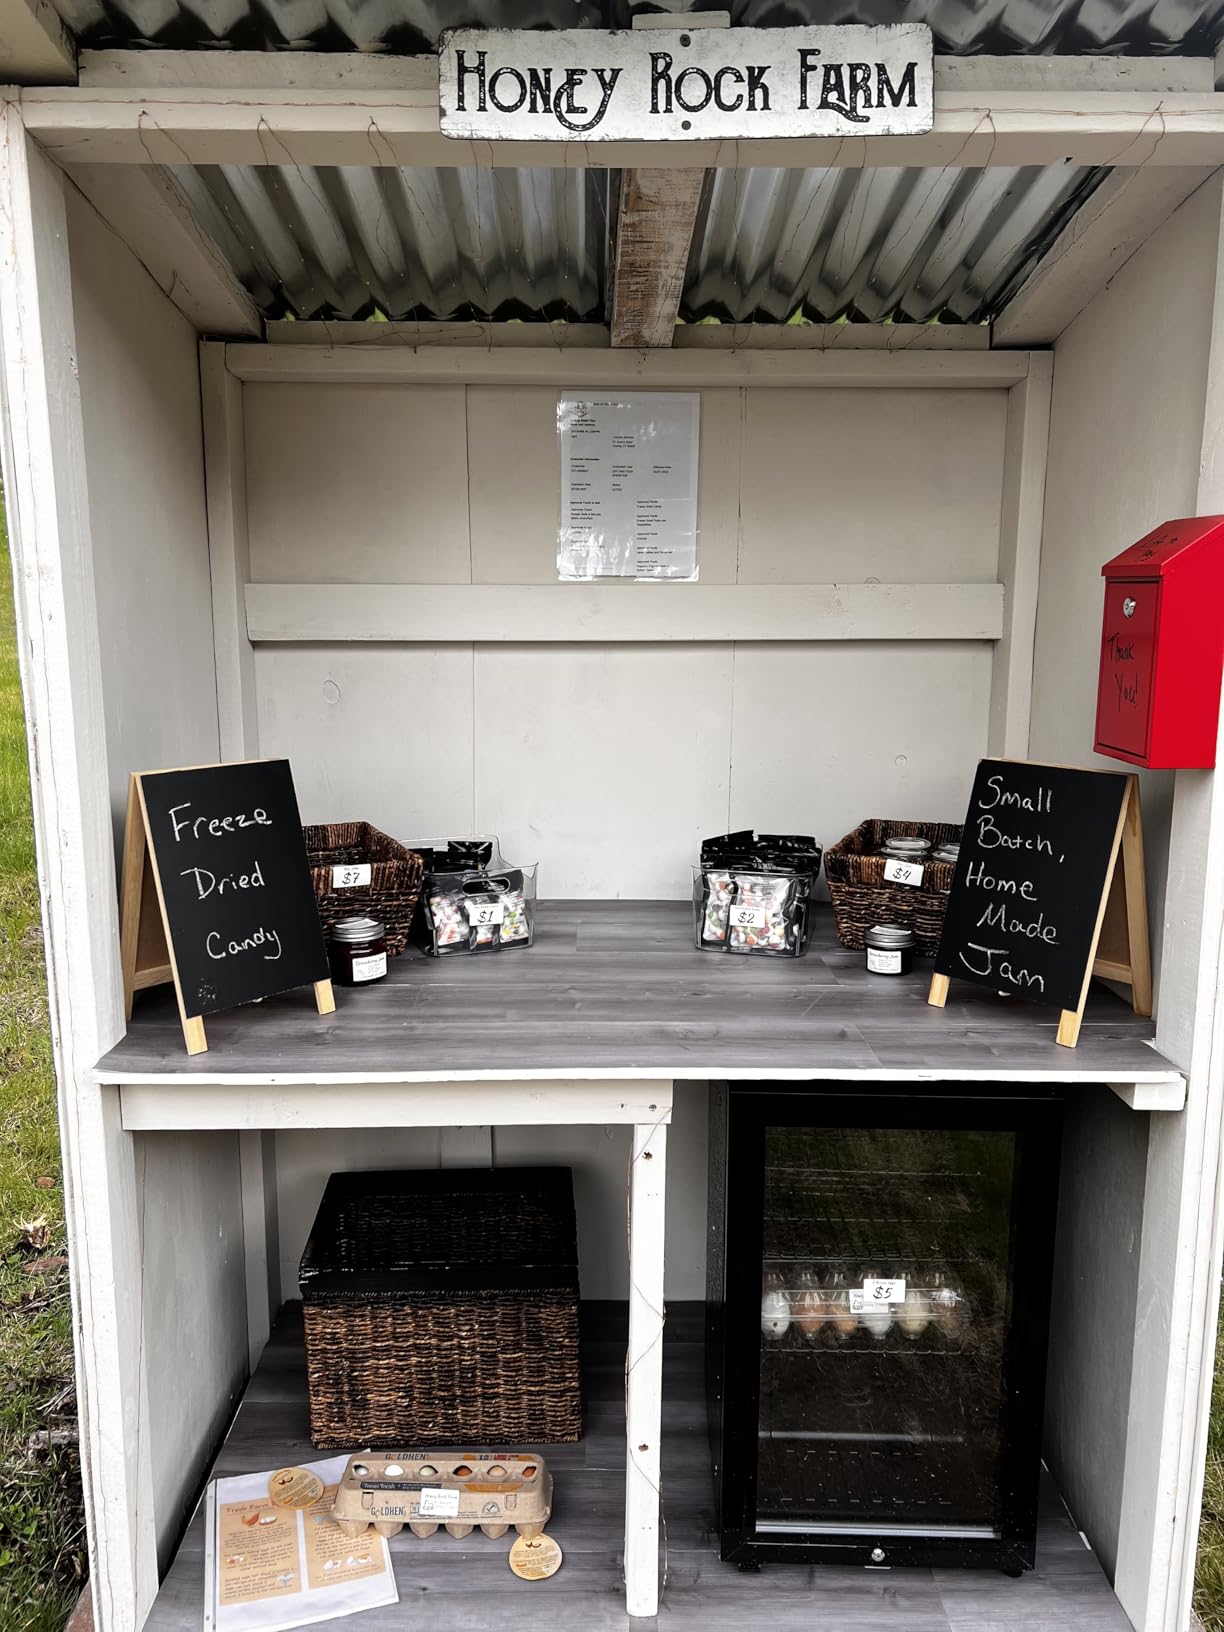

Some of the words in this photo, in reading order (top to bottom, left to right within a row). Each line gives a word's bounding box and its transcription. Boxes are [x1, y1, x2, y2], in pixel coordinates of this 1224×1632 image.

[455, 49, 624, 132] HONEY
[648, 51, 772, 115] ROCK
[797, 48, 919, 123] FARM
[1106, 631, 1135, 663] Thank
[978, 775, 1053, 813] Small
[168, 802, 273, 842] Freeze
[976, 814, 1066, 864] Batch,
[180, 860, 266, 900] Dried
[341, 871, 361, 886] $7
[892, 866, 912, 881] $4
[965, 860, 1038, 901] Home
[477, 909, 494, 924] $1
[737, 911, 755, 924] $2
[976, 902, 1061, 945] Made
[206, 927, 282, 960] Candy
[958, 942, 1045, 993] Jam
[873, 1285, 894, 1300] $5
